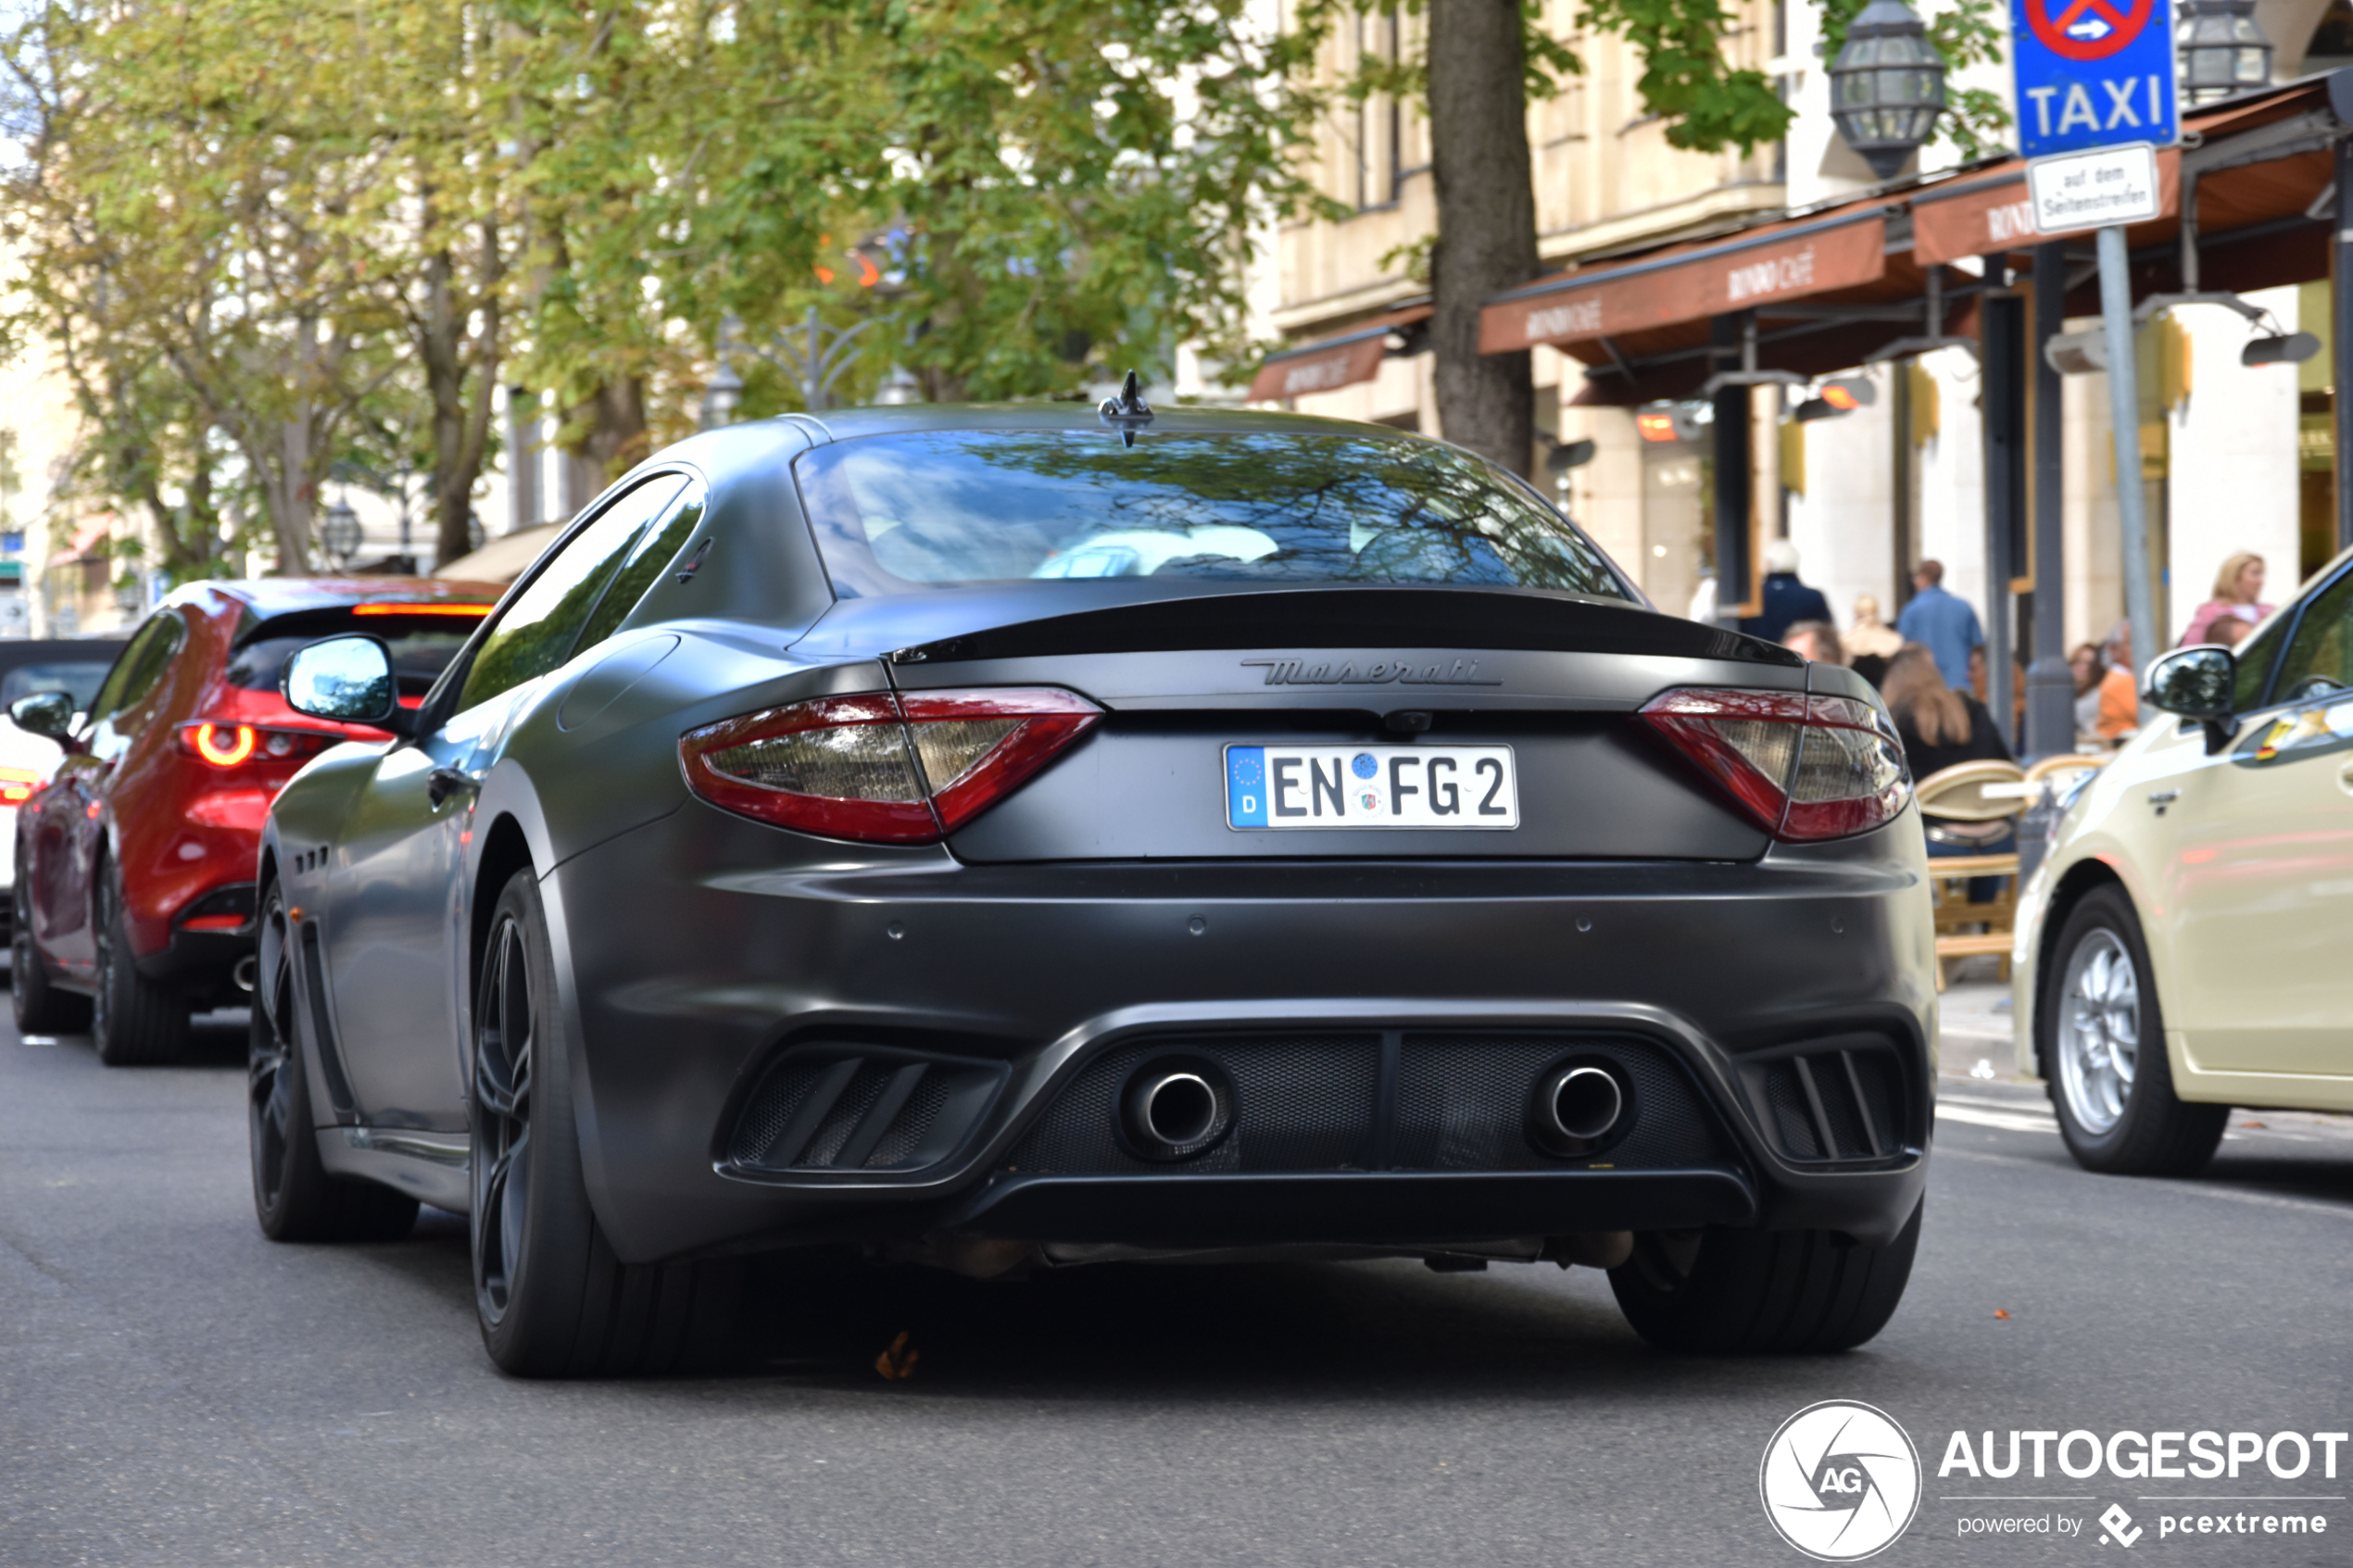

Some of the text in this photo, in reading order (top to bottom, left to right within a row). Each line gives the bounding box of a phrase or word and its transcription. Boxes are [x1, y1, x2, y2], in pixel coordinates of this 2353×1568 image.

[2026, 74, 2161, 137] TAXI
[2064, 167, 2125, 188] auf dem
[2044, 186, 2146, 217] Seitenstreifen
[1240, 659, 1504, 686] Maserati
[1242, 796, 1256, 813] D
[1272, 757, 1345, 817] EN
[1390, 756, 1460, 815] FG
[1475, 757, 1507, 816] 2
